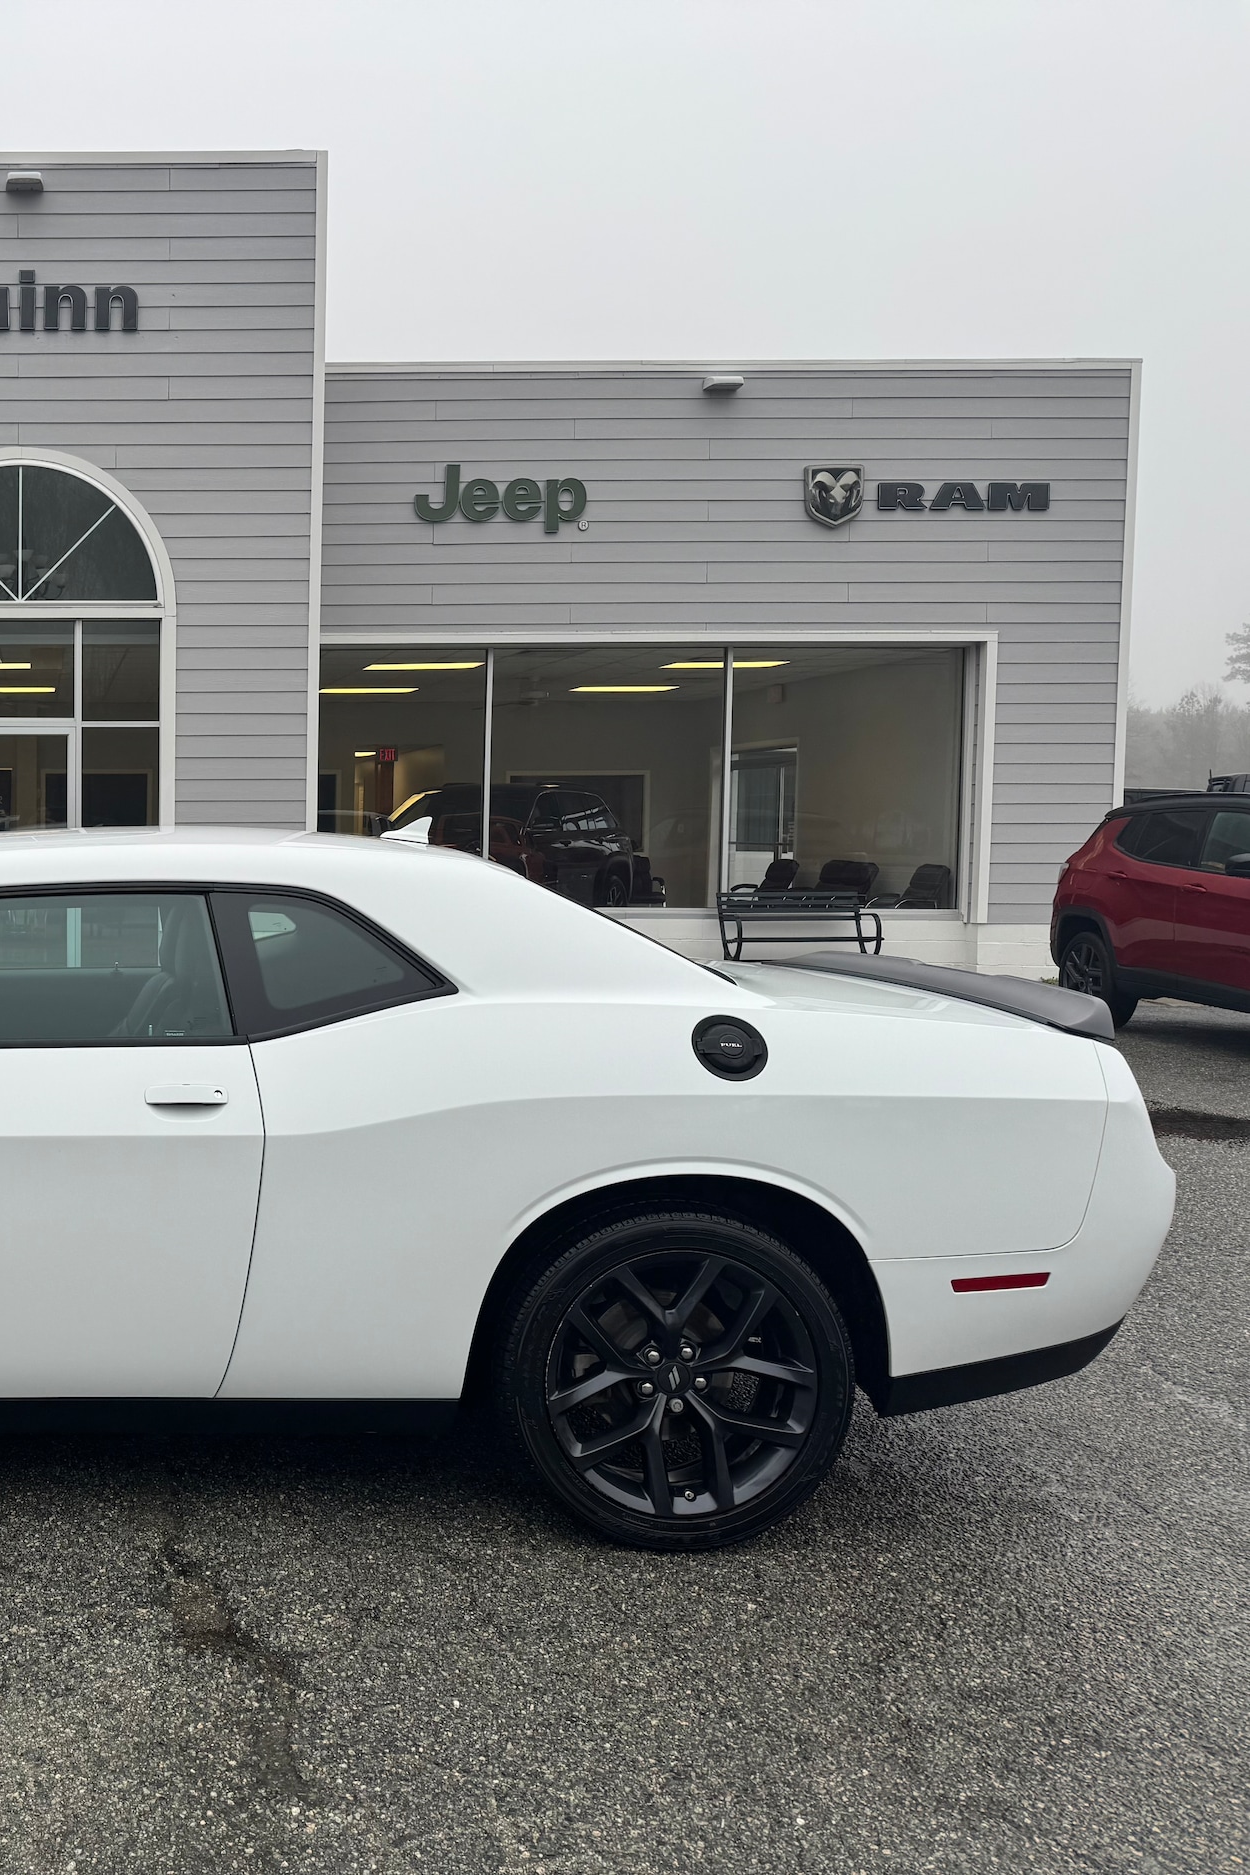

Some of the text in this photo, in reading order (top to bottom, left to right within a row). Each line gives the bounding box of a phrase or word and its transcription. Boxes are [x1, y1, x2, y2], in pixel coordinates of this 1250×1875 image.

[414, 463, 588, 534] Jeep
[877, 481, 1051, 511] RAM
[380, 749, 395, 761] EXIT
